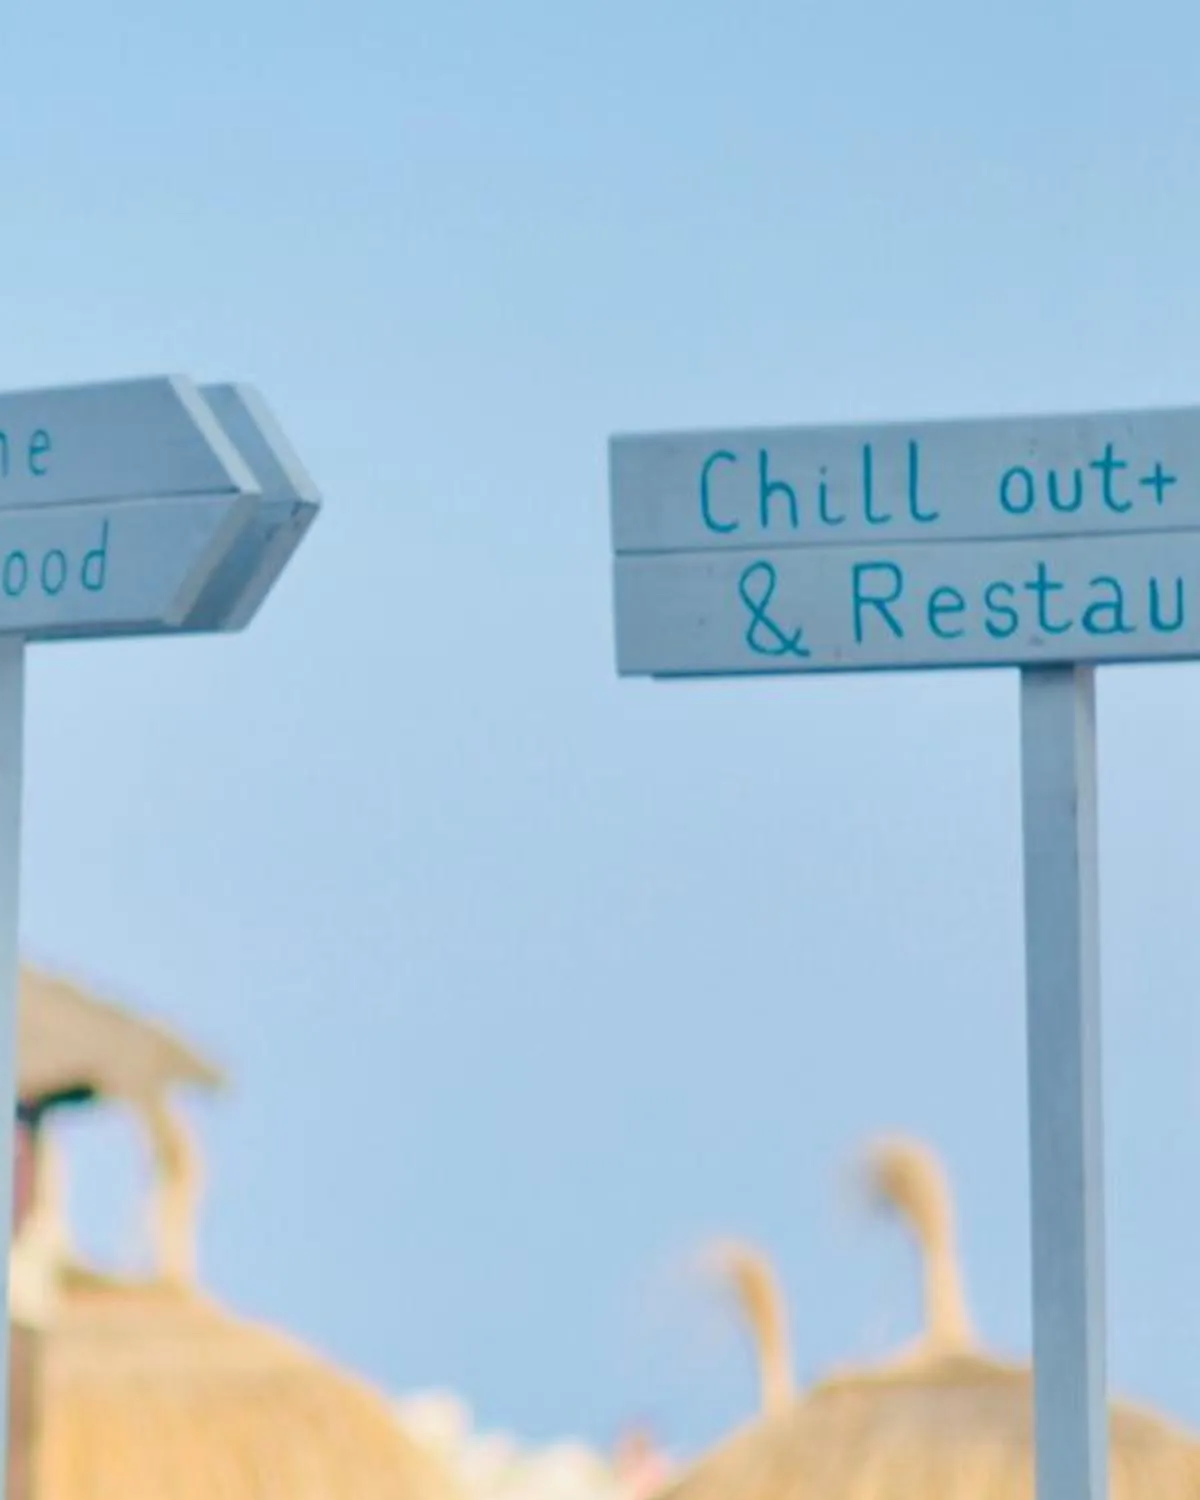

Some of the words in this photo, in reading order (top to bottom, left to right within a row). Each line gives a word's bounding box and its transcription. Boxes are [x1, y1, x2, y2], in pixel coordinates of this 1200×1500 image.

[700, 440, 941, 534] Chill
[998, 442, 1178, 515] out+
[738, 560, 811, 657] &
[850, 561, 1186, 644] Restau
